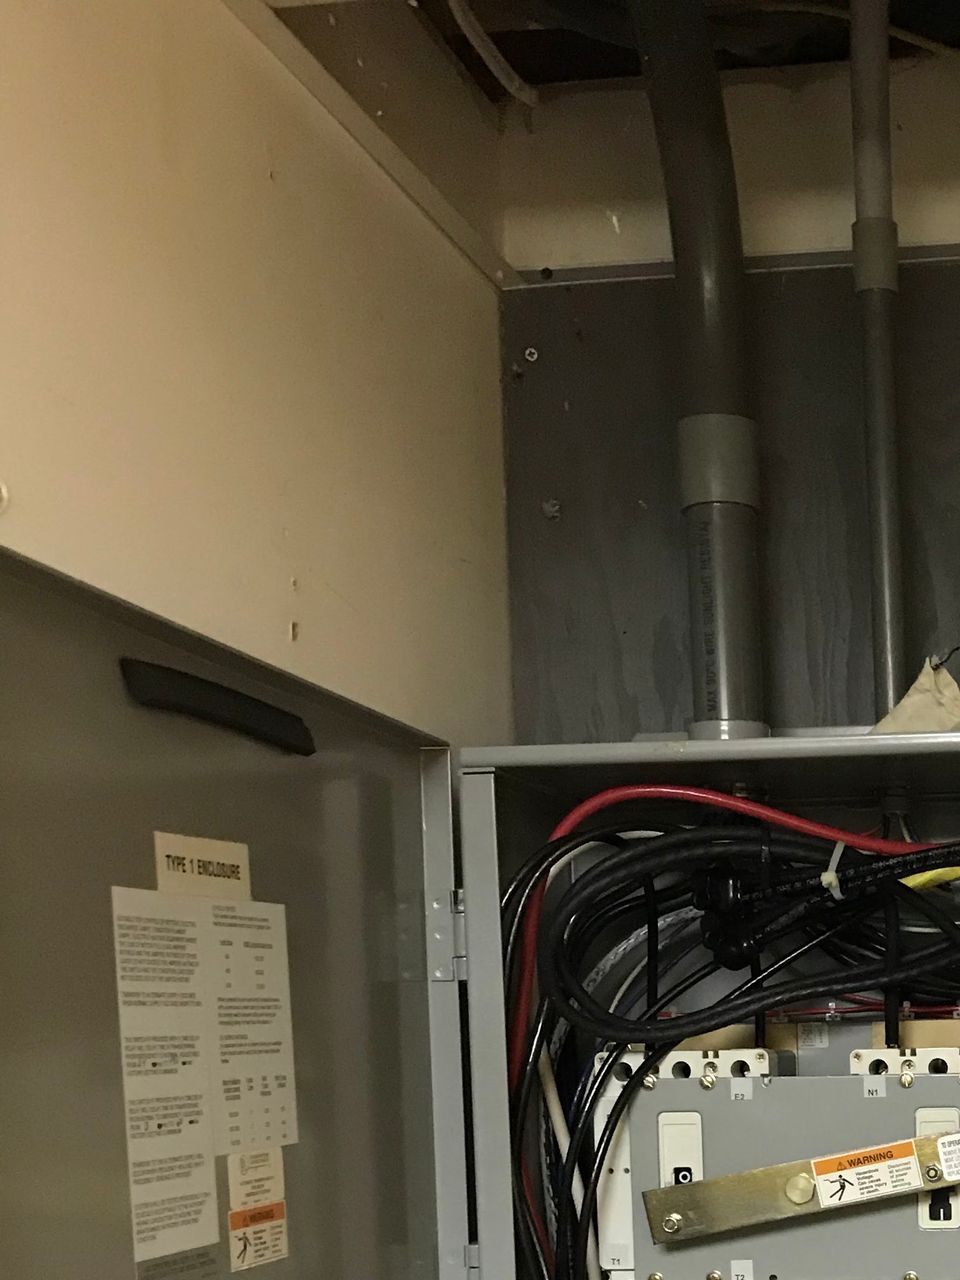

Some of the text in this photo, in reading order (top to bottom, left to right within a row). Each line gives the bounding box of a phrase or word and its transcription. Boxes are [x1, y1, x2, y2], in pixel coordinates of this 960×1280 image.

[165, 854, 187, 873] TYPE
[198, 859, 240, 880] ENCLOSURE
[847, 1151, 895, 1167] WARNING
